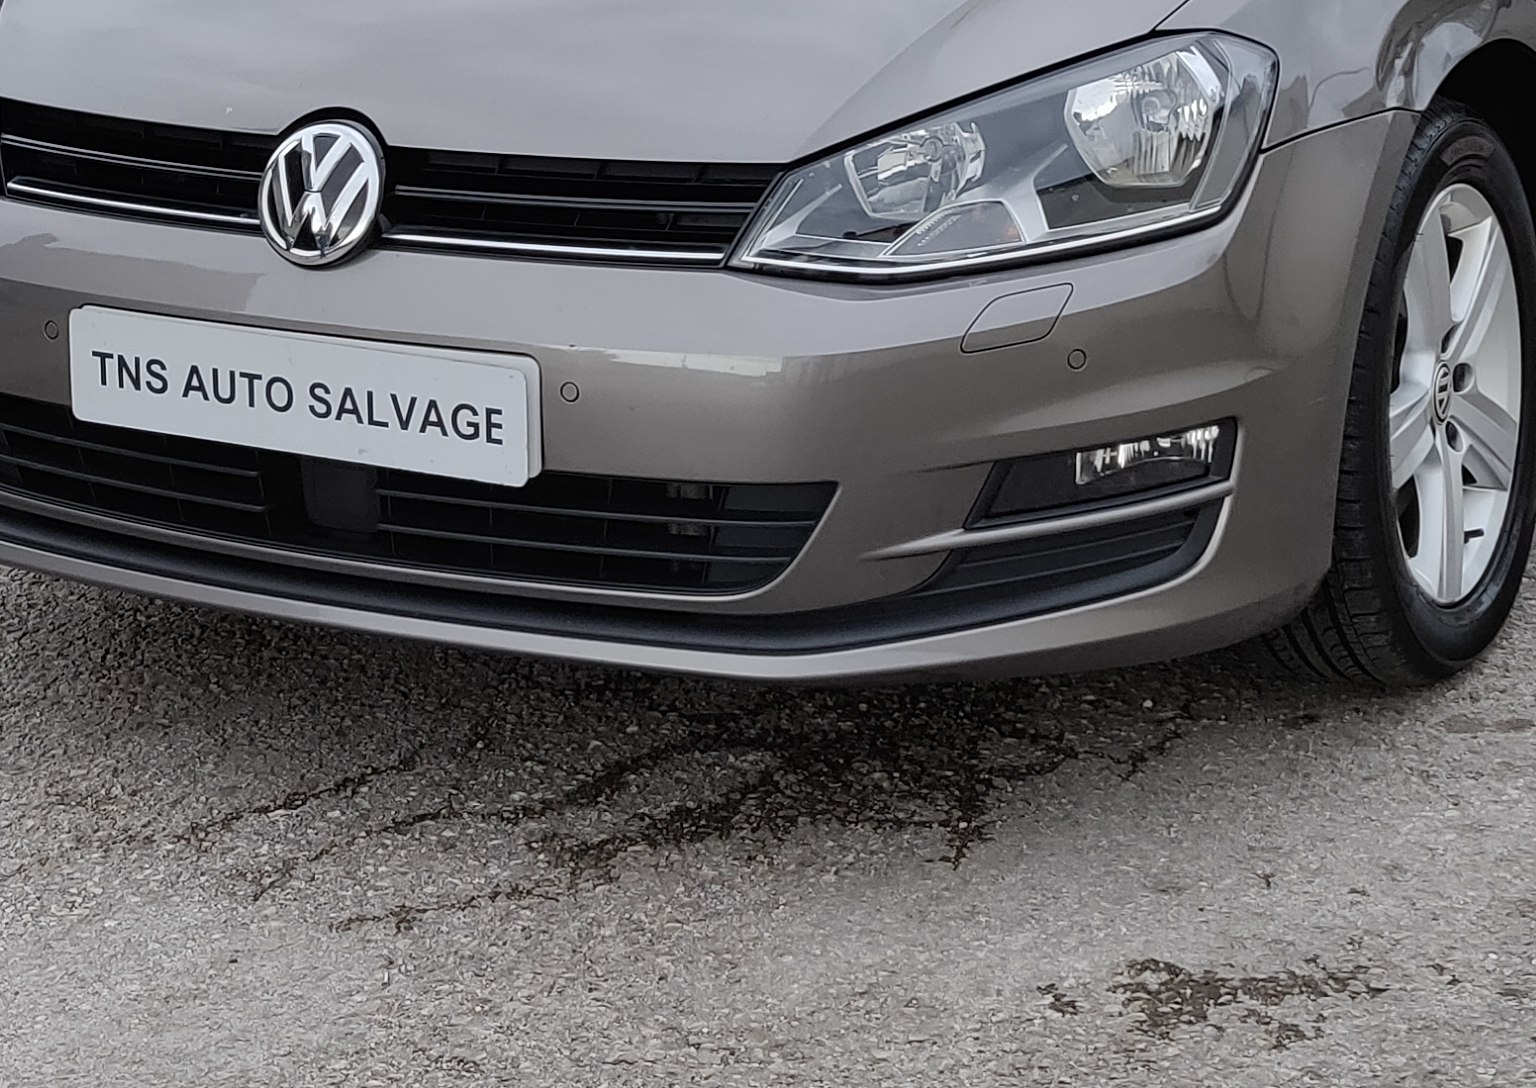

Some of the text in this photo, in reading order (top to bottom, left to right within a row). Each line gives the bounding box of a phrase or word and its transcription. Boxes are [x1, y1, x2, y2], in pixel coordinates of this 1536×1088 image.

[91, 350, 504, 446] TNS AUTO SALVAGE
